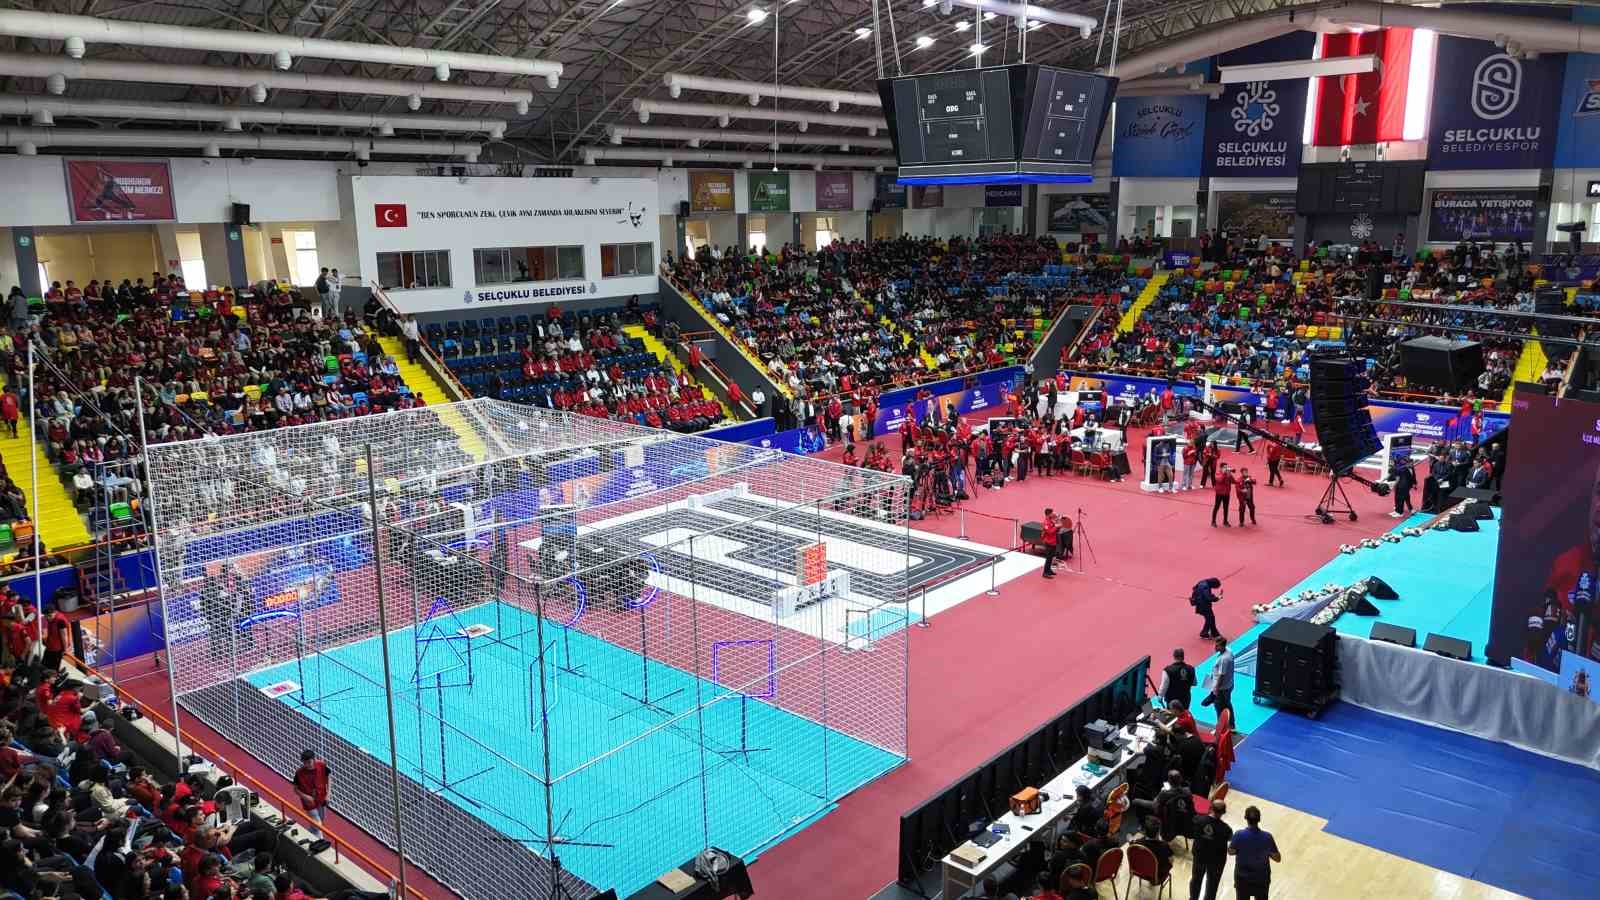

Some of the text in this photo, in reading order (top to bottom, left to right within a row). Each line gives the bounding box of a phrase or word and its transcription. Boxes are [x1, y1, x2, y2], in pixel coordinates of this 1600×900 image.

[1443, 127, 1541, 143] SELÇUKLU
[1217, 141, 1288, 156] SELÇUKLU
[1216, 154, 1287, 167] BELEDİYESİ
[478, 289, 530, 302] SELÇUKLU
